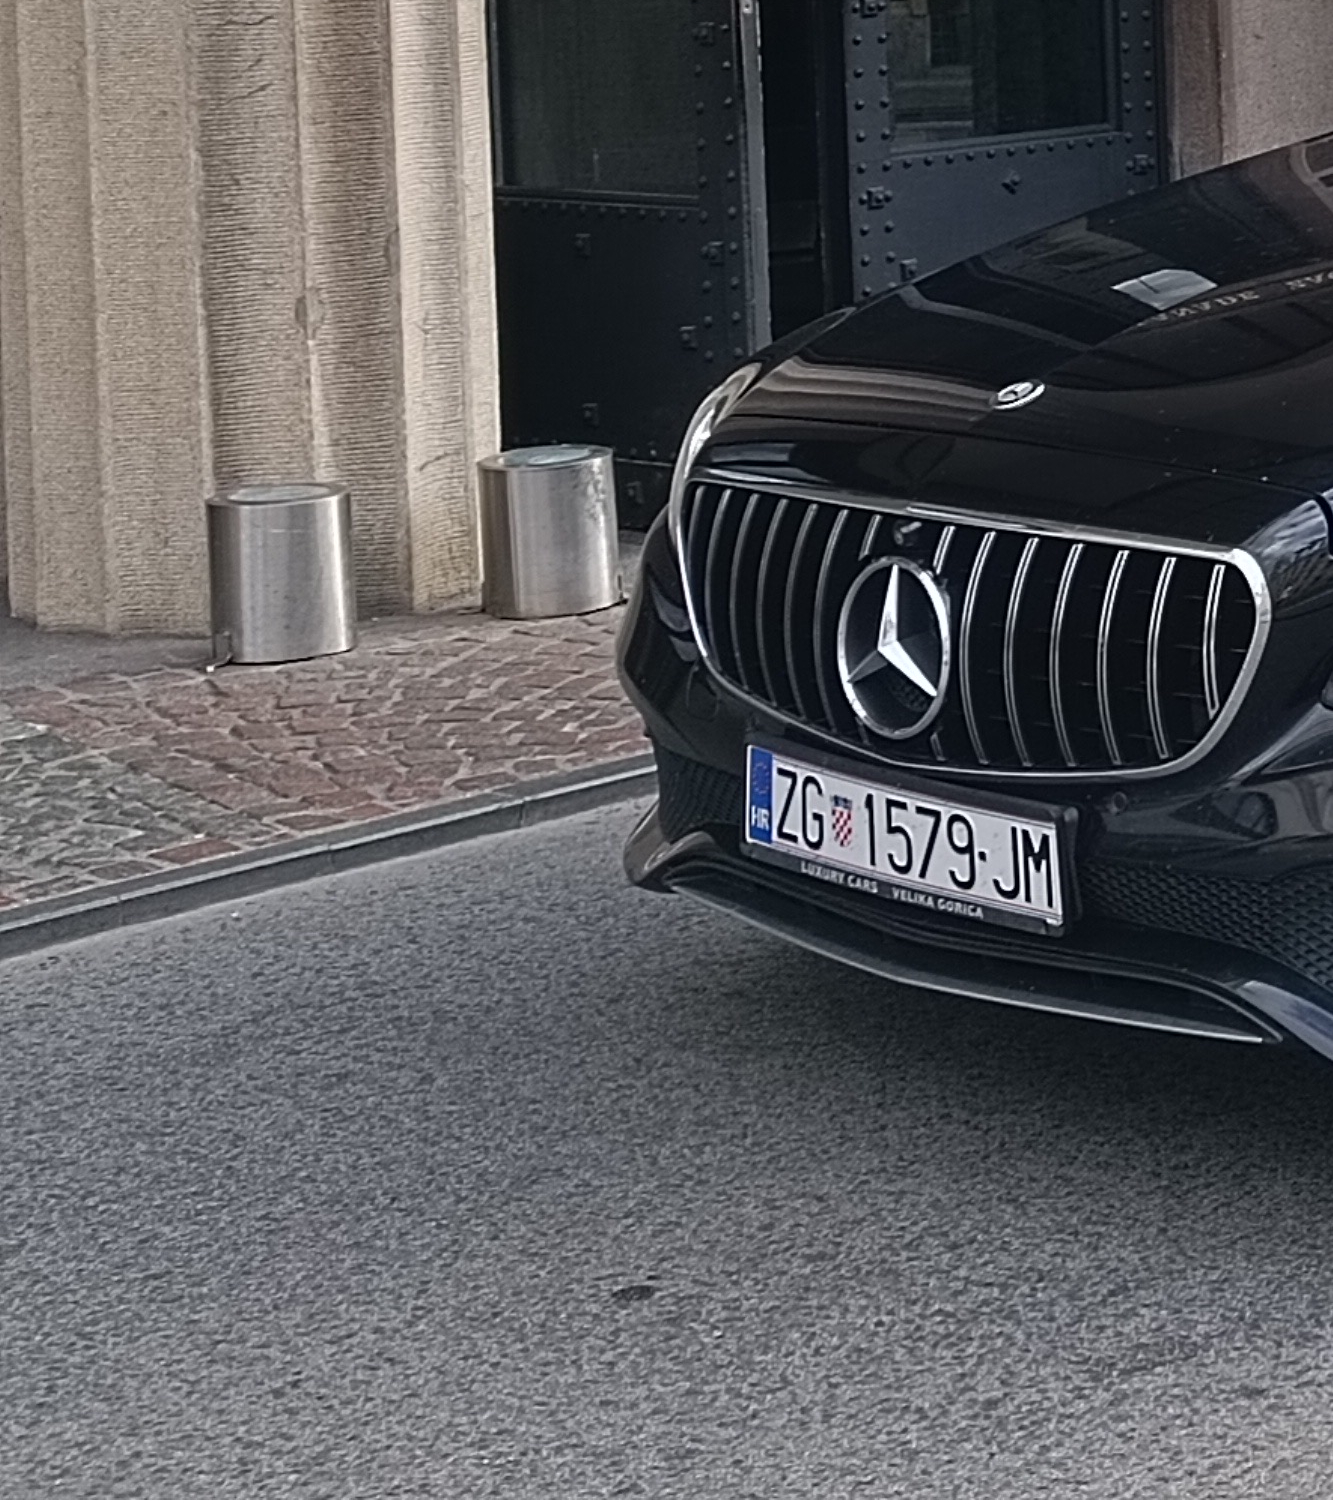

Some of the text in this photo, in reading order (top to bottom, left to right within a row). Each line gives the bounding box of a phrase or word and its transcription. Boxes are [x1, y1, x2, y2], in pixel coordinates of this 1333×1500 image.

[750, 804, 770, 831] HR
[776, 766, 825, 851] ZG
[800, 860, 985, 920] LUXURY CARS VELIKA GORICA
